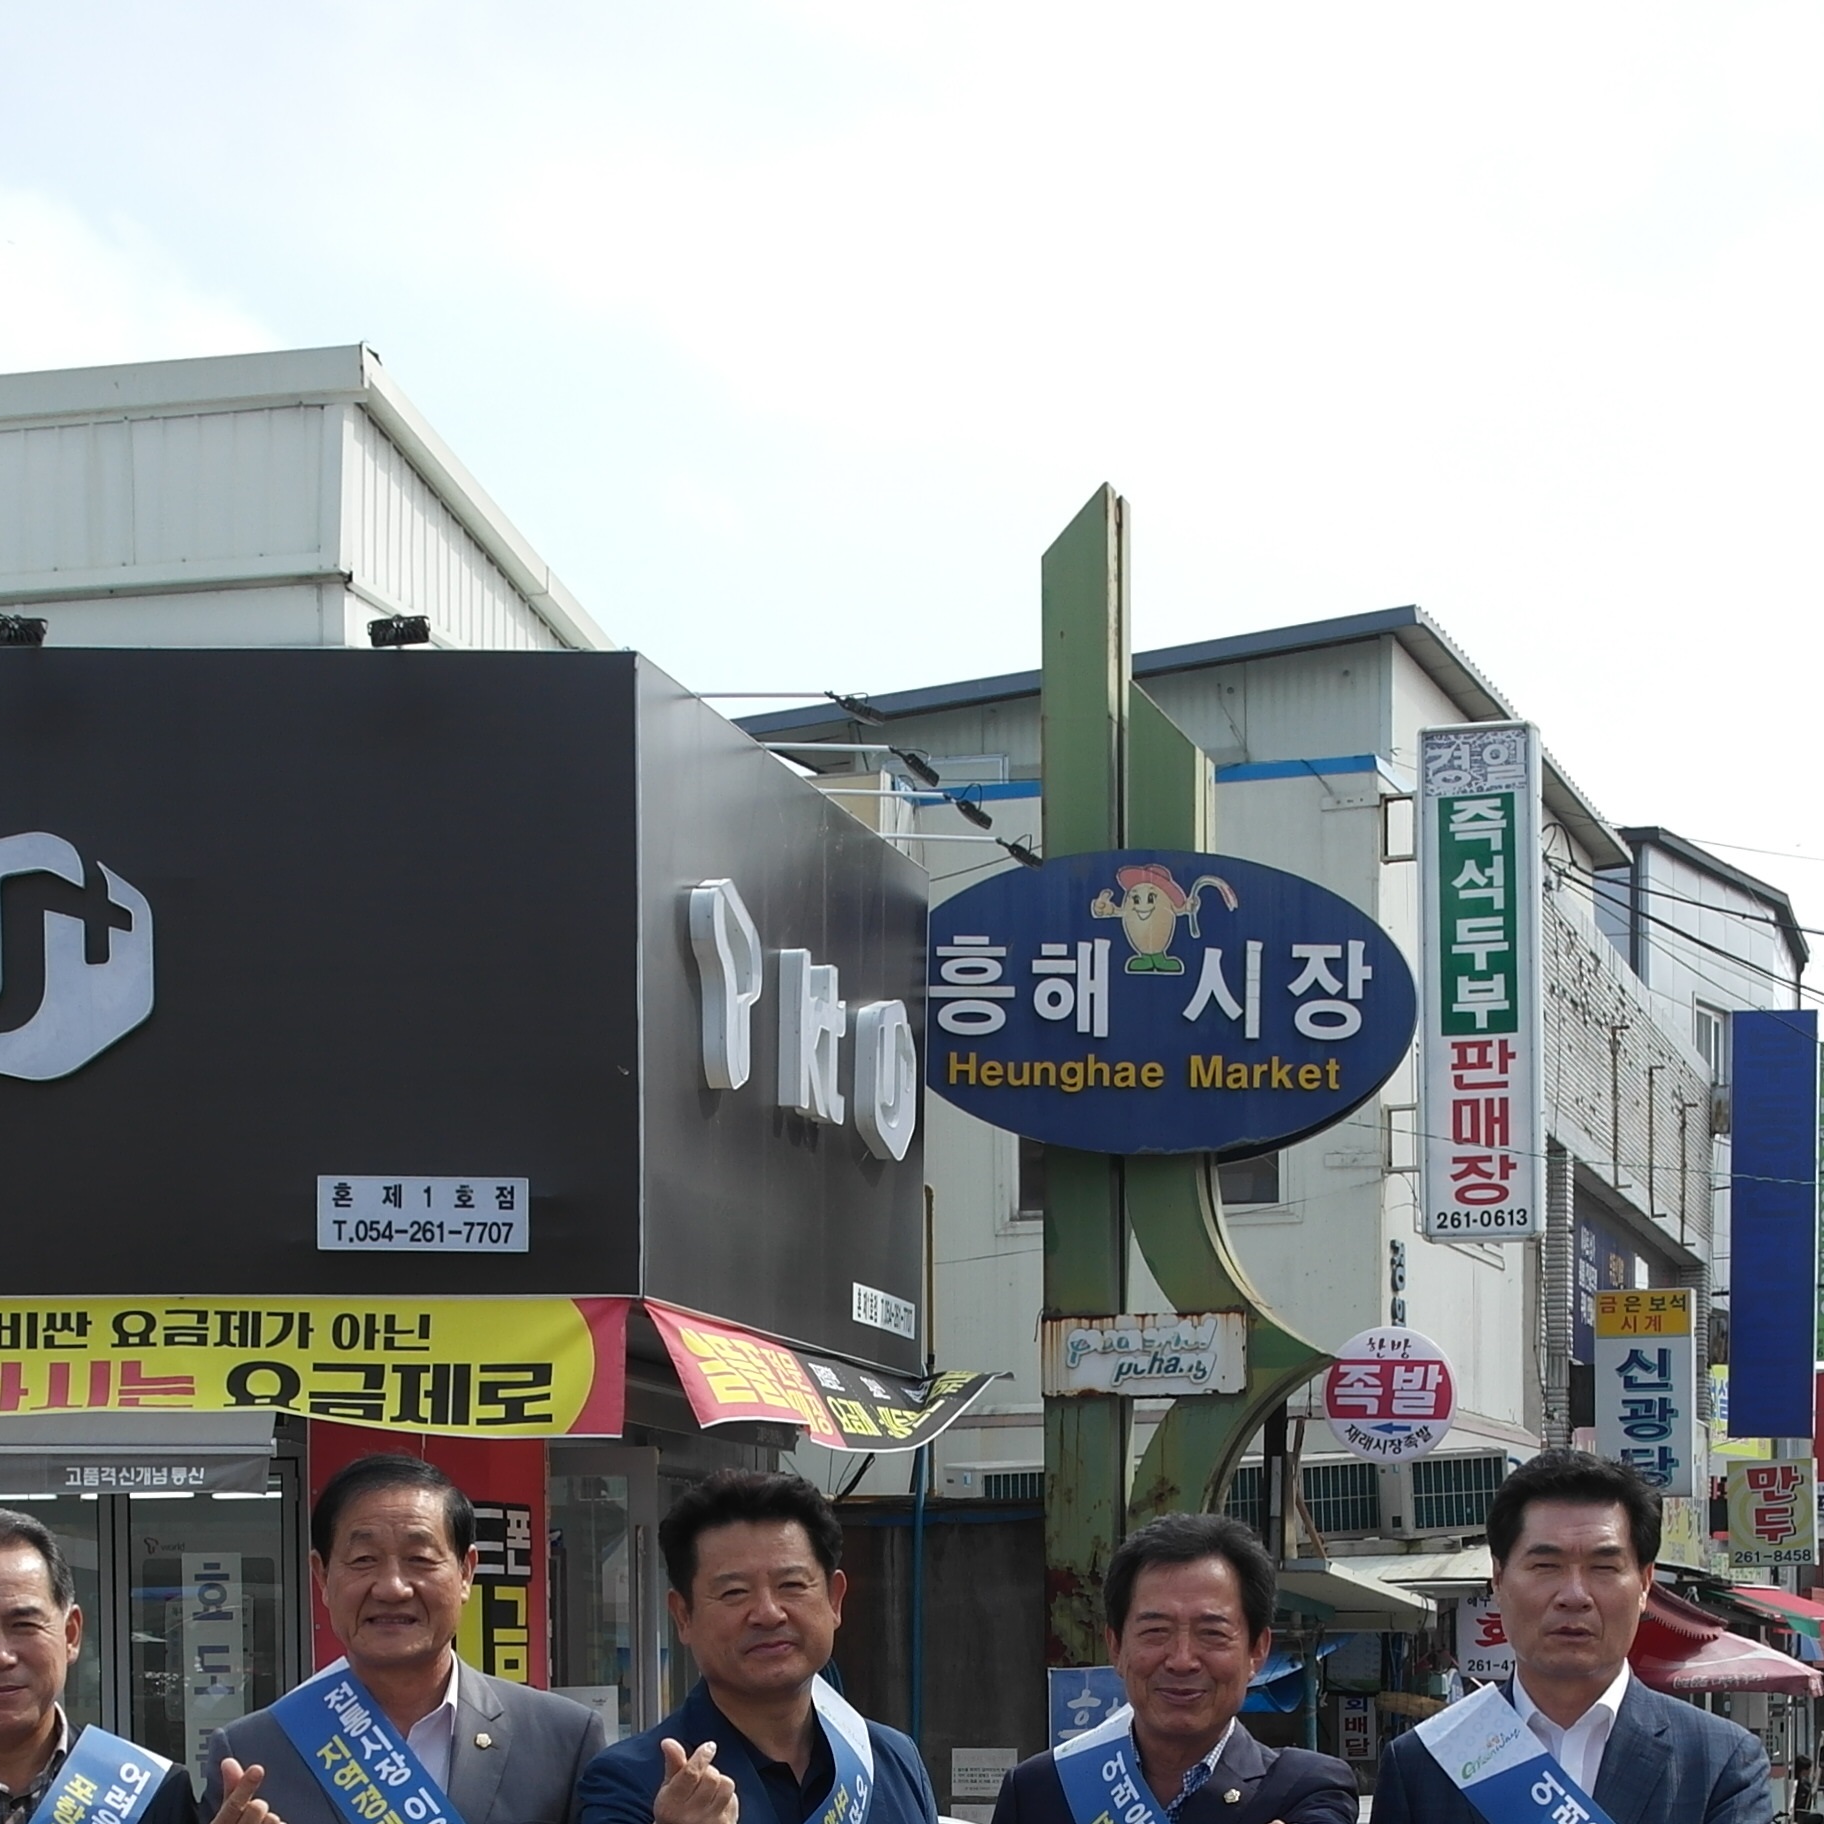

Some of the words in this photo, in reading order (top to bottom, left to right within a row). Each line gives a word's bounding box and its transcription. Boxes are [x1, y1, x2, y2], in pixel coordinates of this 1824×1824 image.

[1426, 737, 1528, 792] 경일
[1447, 798, 1510, 1030] 즉석두부
[928, 936, 1109, 1039] 흥해
[1182, 939, 1373, 1042] 시장
[777, 948, 846, 1128] kt
[948, 1053, 1164, 1093] Heunghae
[1190, 1054, 1341, 1091] Market
[1450, 1038, 1517, 1206] 판매장
[332, 1218, 516, 1246] T.054-261-7707
[1435, 1206, 1529, 1231] 261-0613
[110, 1310, 314, 1350] 요금제가
[331, 1312, 432, 1352] 아닌
[226, 1361, 556, 1426] 요금제로
[1334, 1364, 1443, 1416] 족발
[1746, 1465, 1804, 1547] 만두
[1735, 1549, 1812, 1563] 261-8458
[322, 1680, 409, 1790] 전통시장
